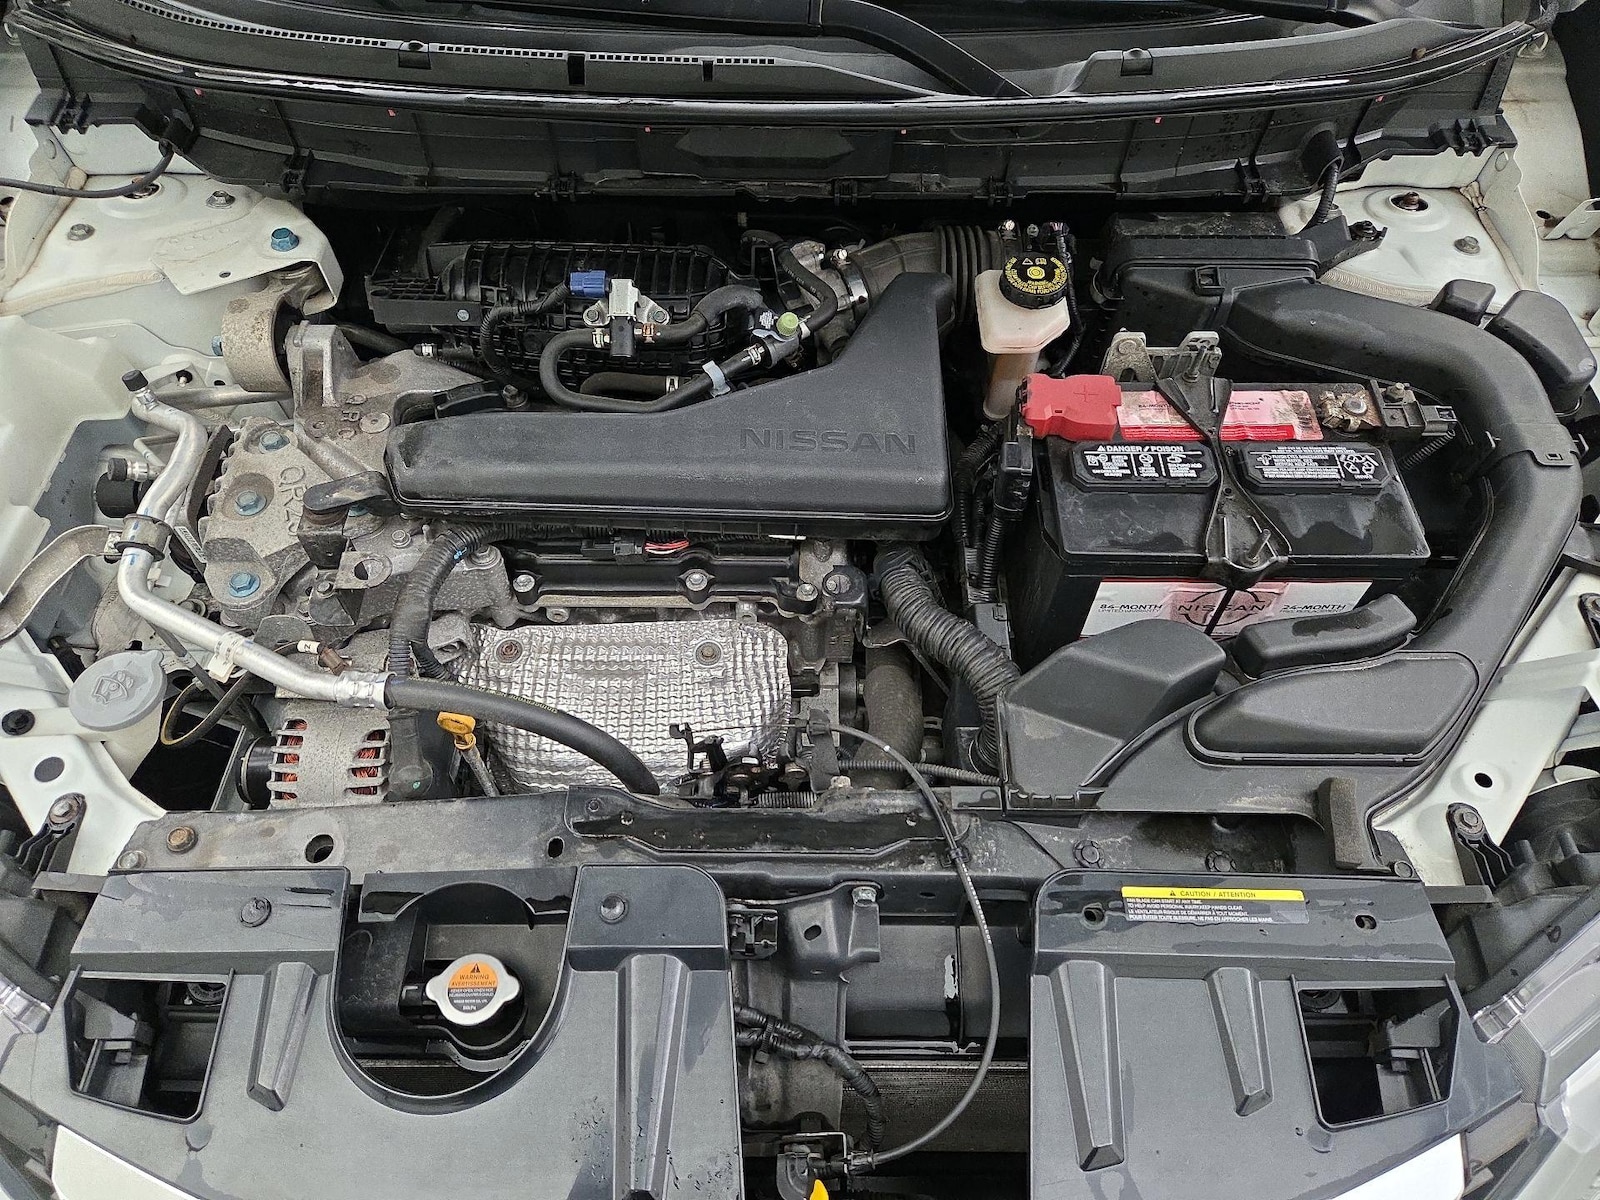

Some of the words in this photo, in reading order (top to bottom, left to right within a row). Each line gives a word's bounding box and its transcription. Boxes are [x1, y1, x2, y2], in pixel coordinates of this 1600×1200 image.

[739, 427, 917, 455] NISSAN
[1177, 604, 1266, 612] NISSAN
[1180, 890, 1211, 898] CAUTION
